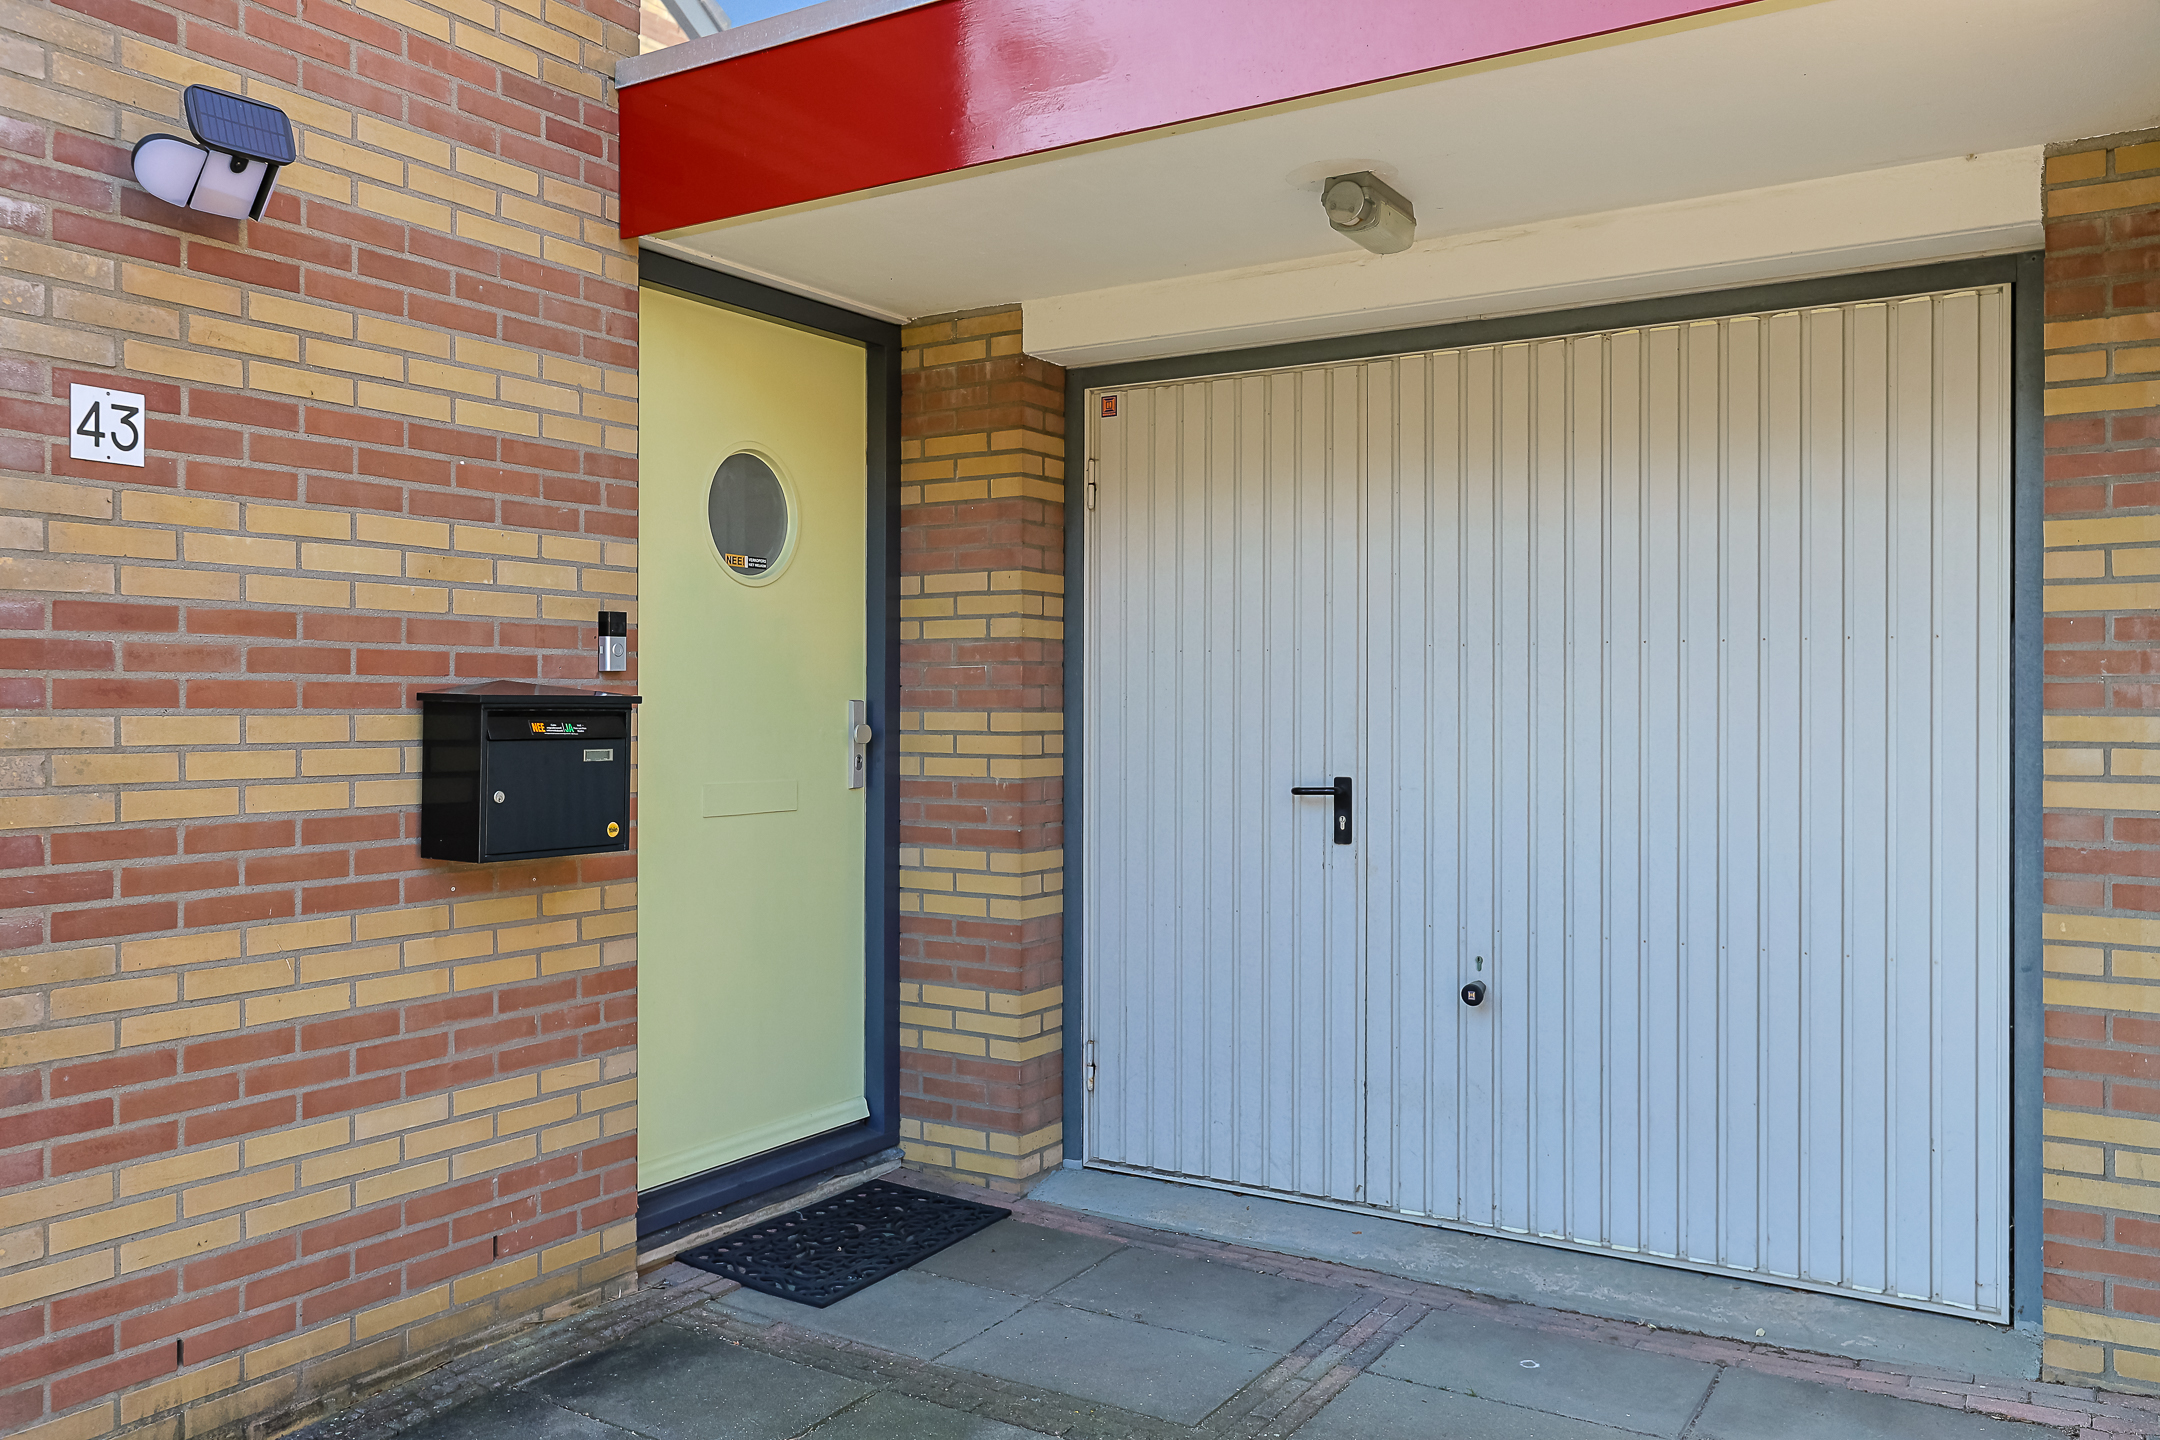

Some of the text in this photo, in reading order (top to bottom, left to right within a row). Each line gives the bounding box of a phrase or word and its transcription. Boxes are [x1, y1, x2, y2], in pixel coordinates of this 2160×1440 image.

[77, 401, 139, 452] 43
[531, 722, 546, 733] NEE
[564, 723, 575, 733] JA
